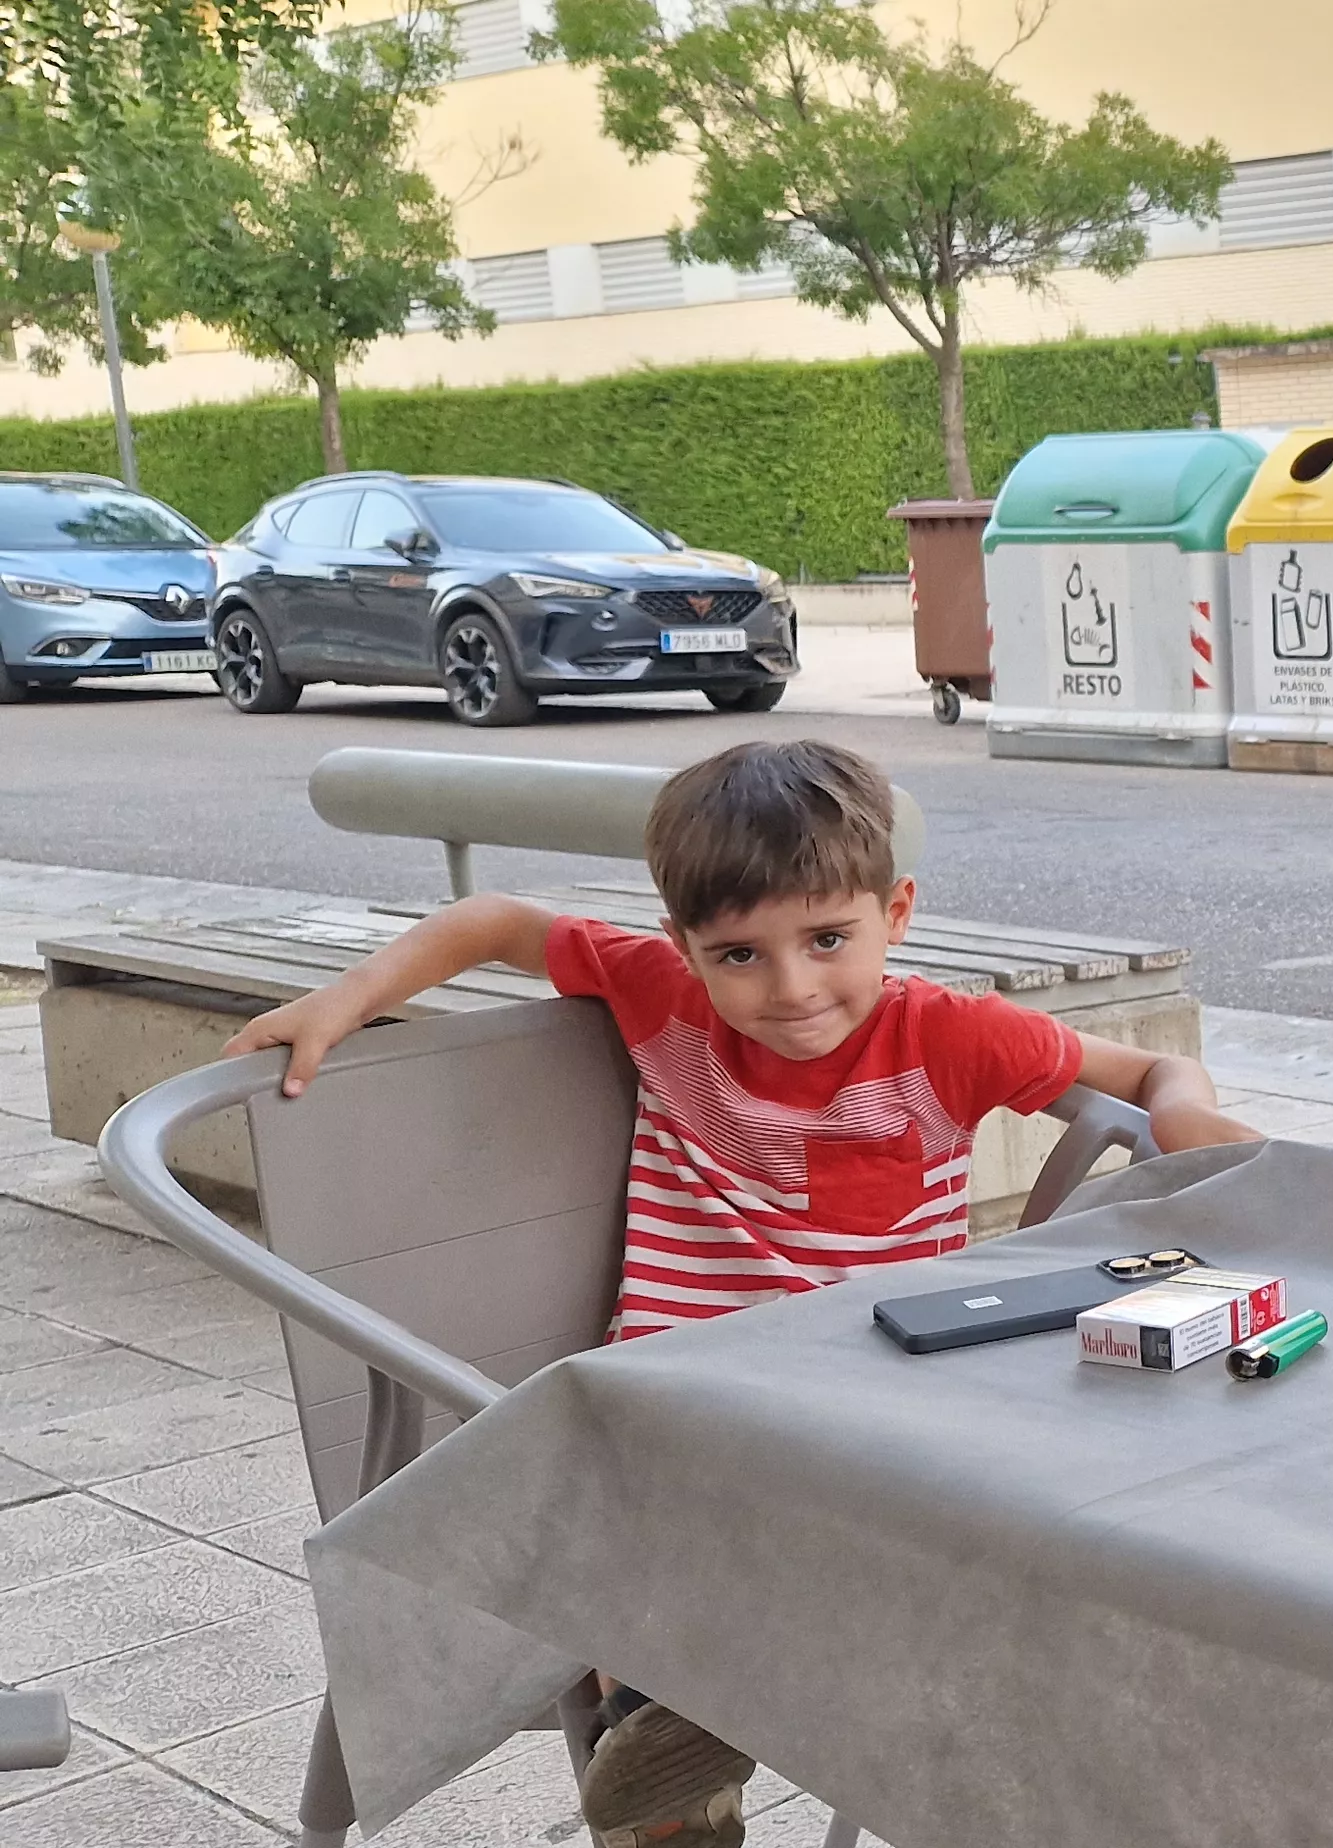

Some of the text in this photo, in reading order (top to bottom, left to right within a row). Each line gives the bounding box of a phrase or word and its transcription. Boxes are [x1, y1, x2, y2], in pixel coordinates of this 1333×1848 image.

[1274, 665, 1333, 677] ENVASES DE
[1063, 674, 1122, 696] RESTO
[1270, 695, 1298, 705] LATAS
[1301, 696, 1307, 705] Y
[1082, 1328, 1137, 1359] Marlboro
